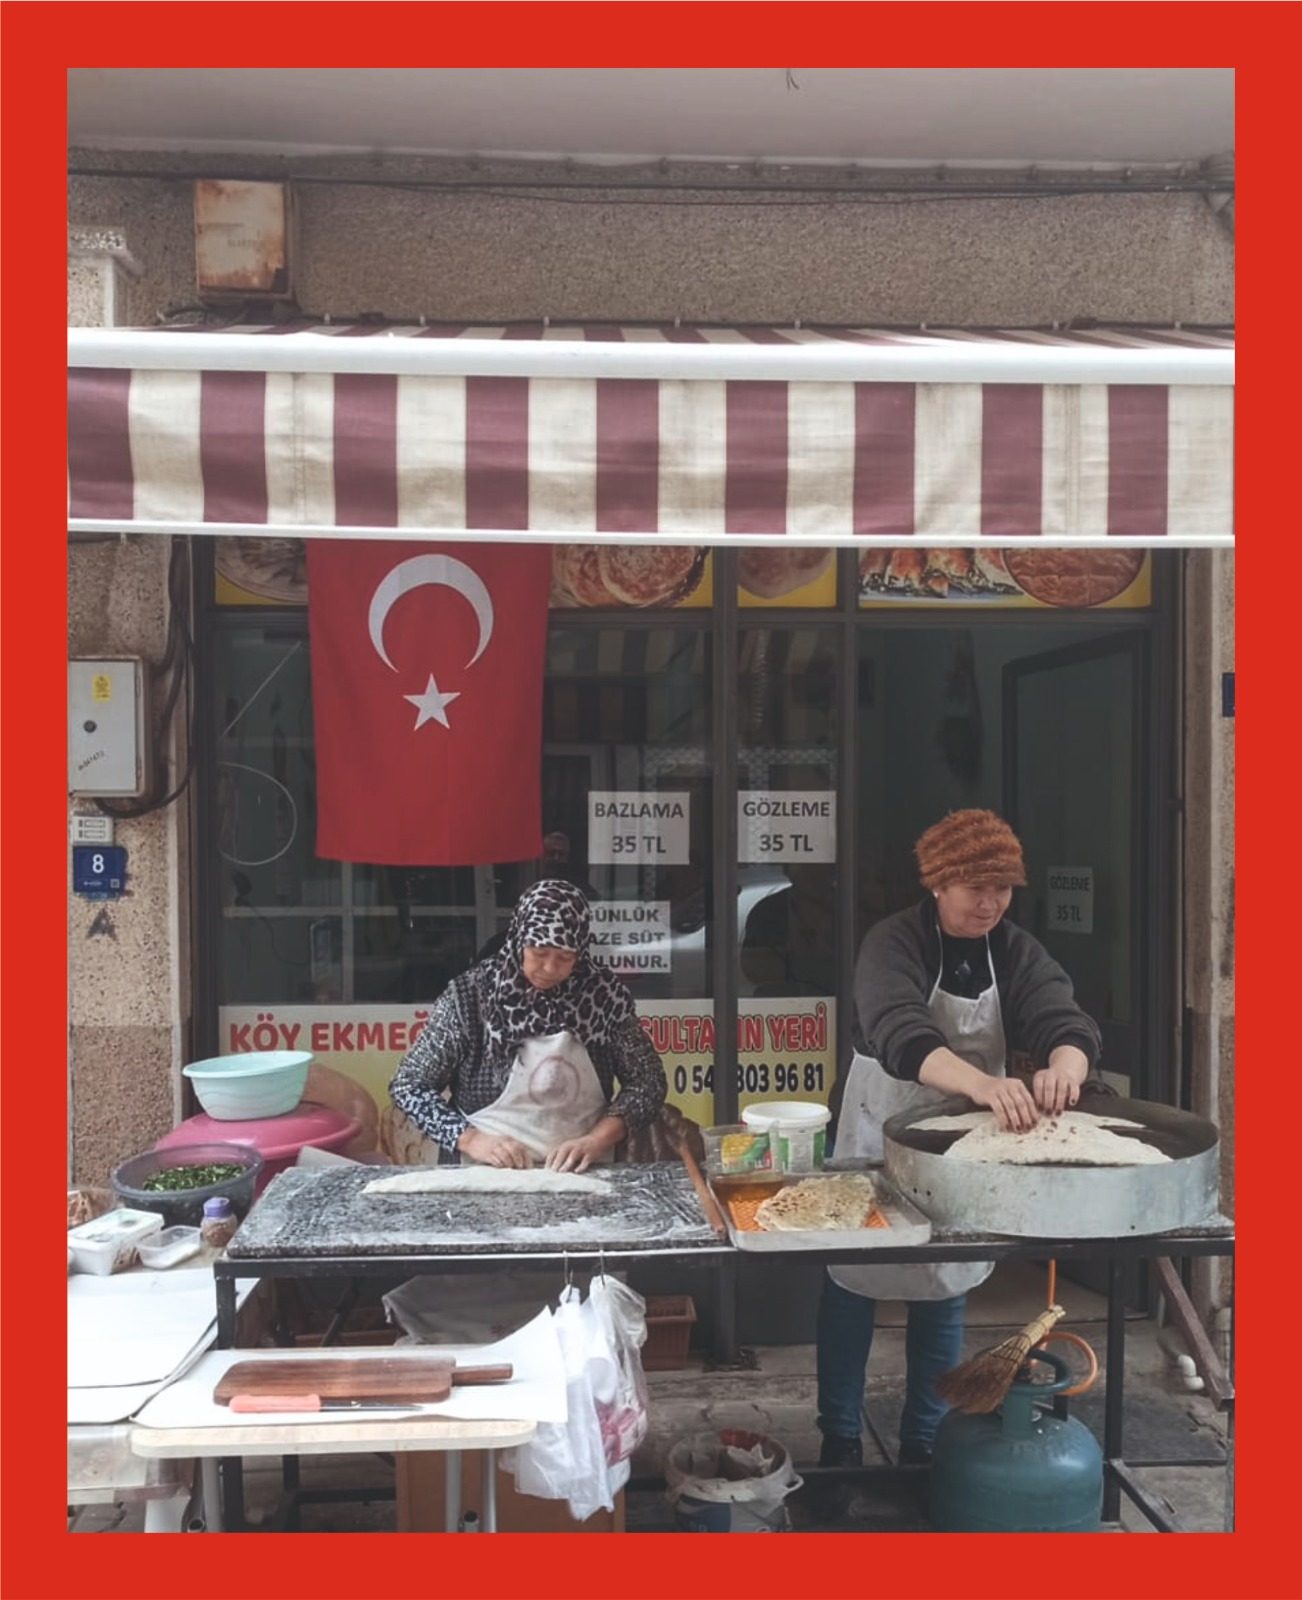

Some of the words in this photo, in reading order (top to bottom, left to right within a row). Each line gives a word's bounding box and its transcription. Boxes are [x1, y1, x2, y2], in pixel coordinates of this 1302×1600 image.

[594, 802, 684, 818] BAZLAMA
[743, 797, 830, 817] GÖZLEME
[611, 835, 637, 853] 35
[642, 835, 666, 853] TL
[759, 834, 784, 852] 35
[790, 834, 814, 852] TL
[92, 854, 104, 874] 8
[588, 932, 622, 945] AZE
[627, 929, 665, 945] SÜT
[230, 1013, 301, 1053] KÖY
[311, 1010, 429, 1053] EKMEĞ
[766, 1002, 827, 1051] YERİ
[675, 1064, 687, 1095] 0
[775, 1063, 799, 1093] 96
[803, 1063, 824, 1092] 81
